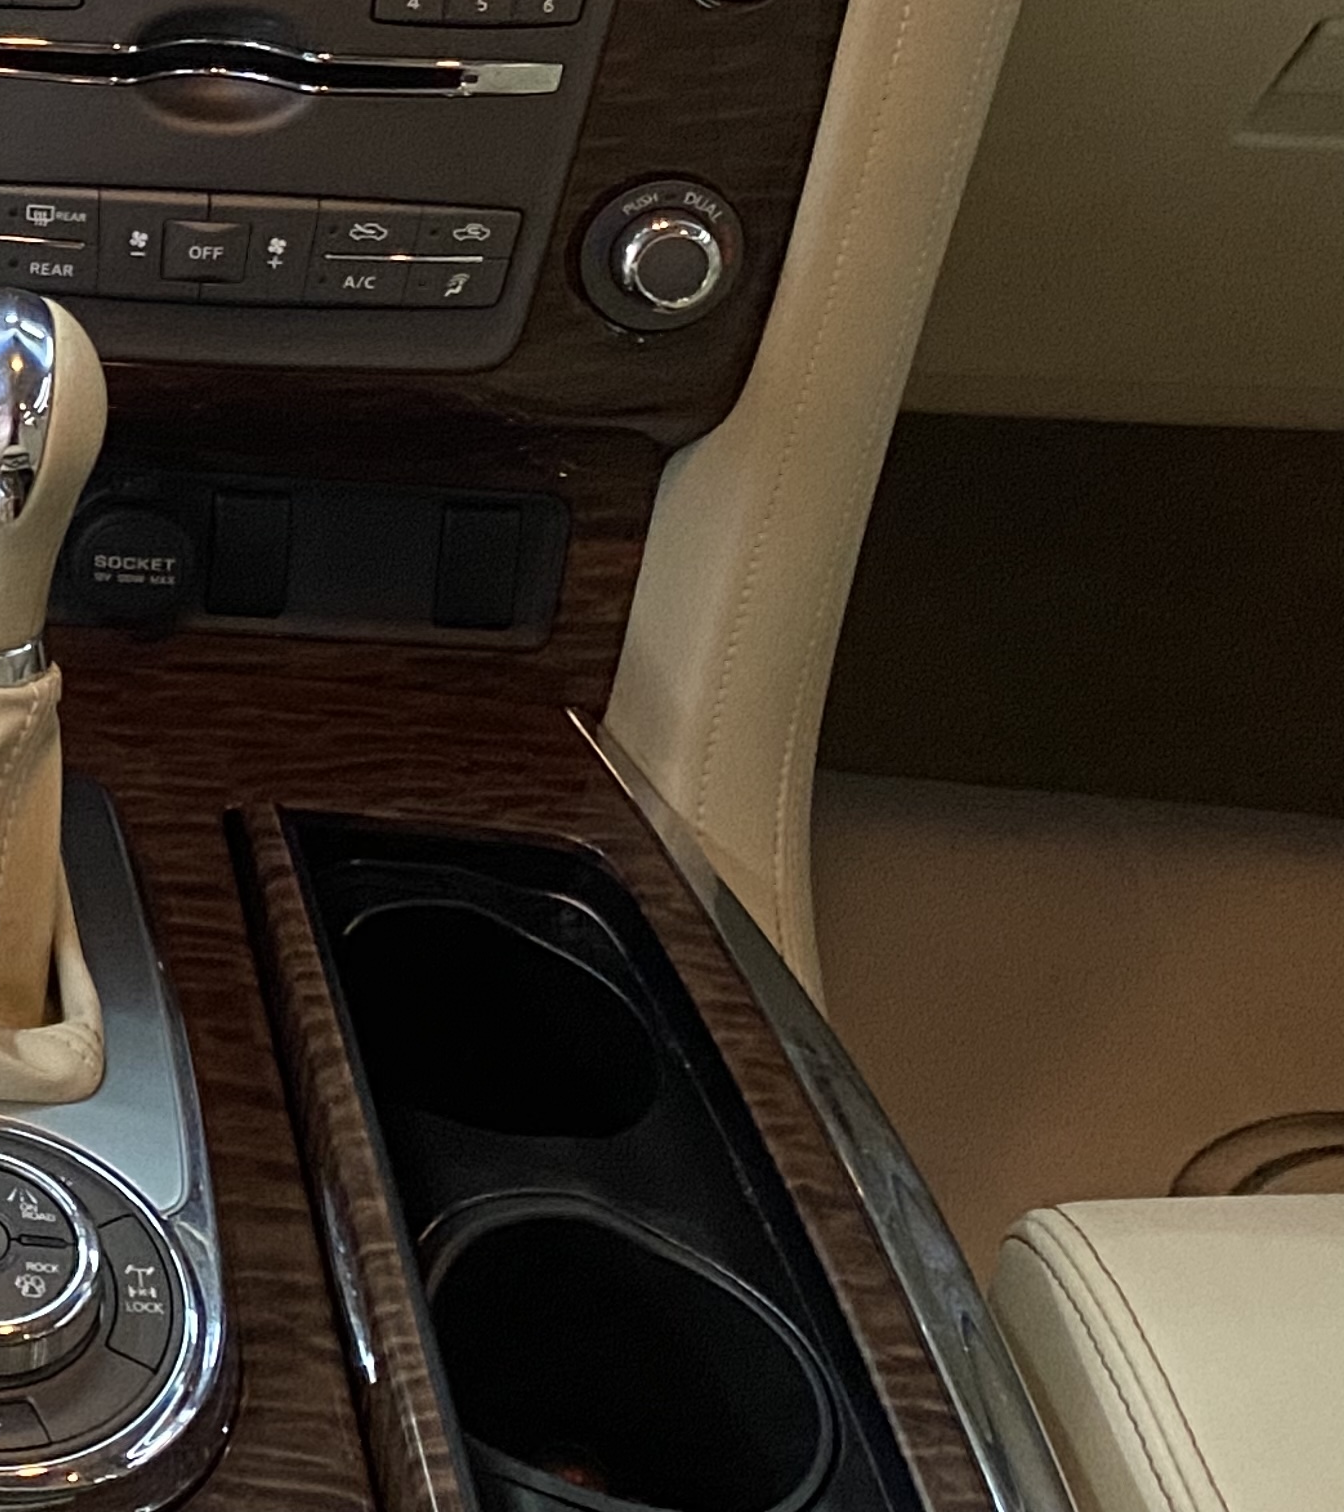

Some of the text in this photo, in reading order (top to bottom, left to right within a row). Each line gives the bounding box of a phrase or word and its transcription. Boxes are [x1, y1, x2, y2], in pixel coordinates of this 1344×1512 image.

[683, 191, 723, 223] DUAL
[55, 211, 86, 222] REAR
[188, 244, 224, 261] OFF
[30, 262, 74, 277] REAR
[343, 274, 375, 290] A/C
[94, 554, 175, 571] SOCKET
[25, 1262, 60, 1273] ROCK
[125, 1301, 164, 1314] LOCK
